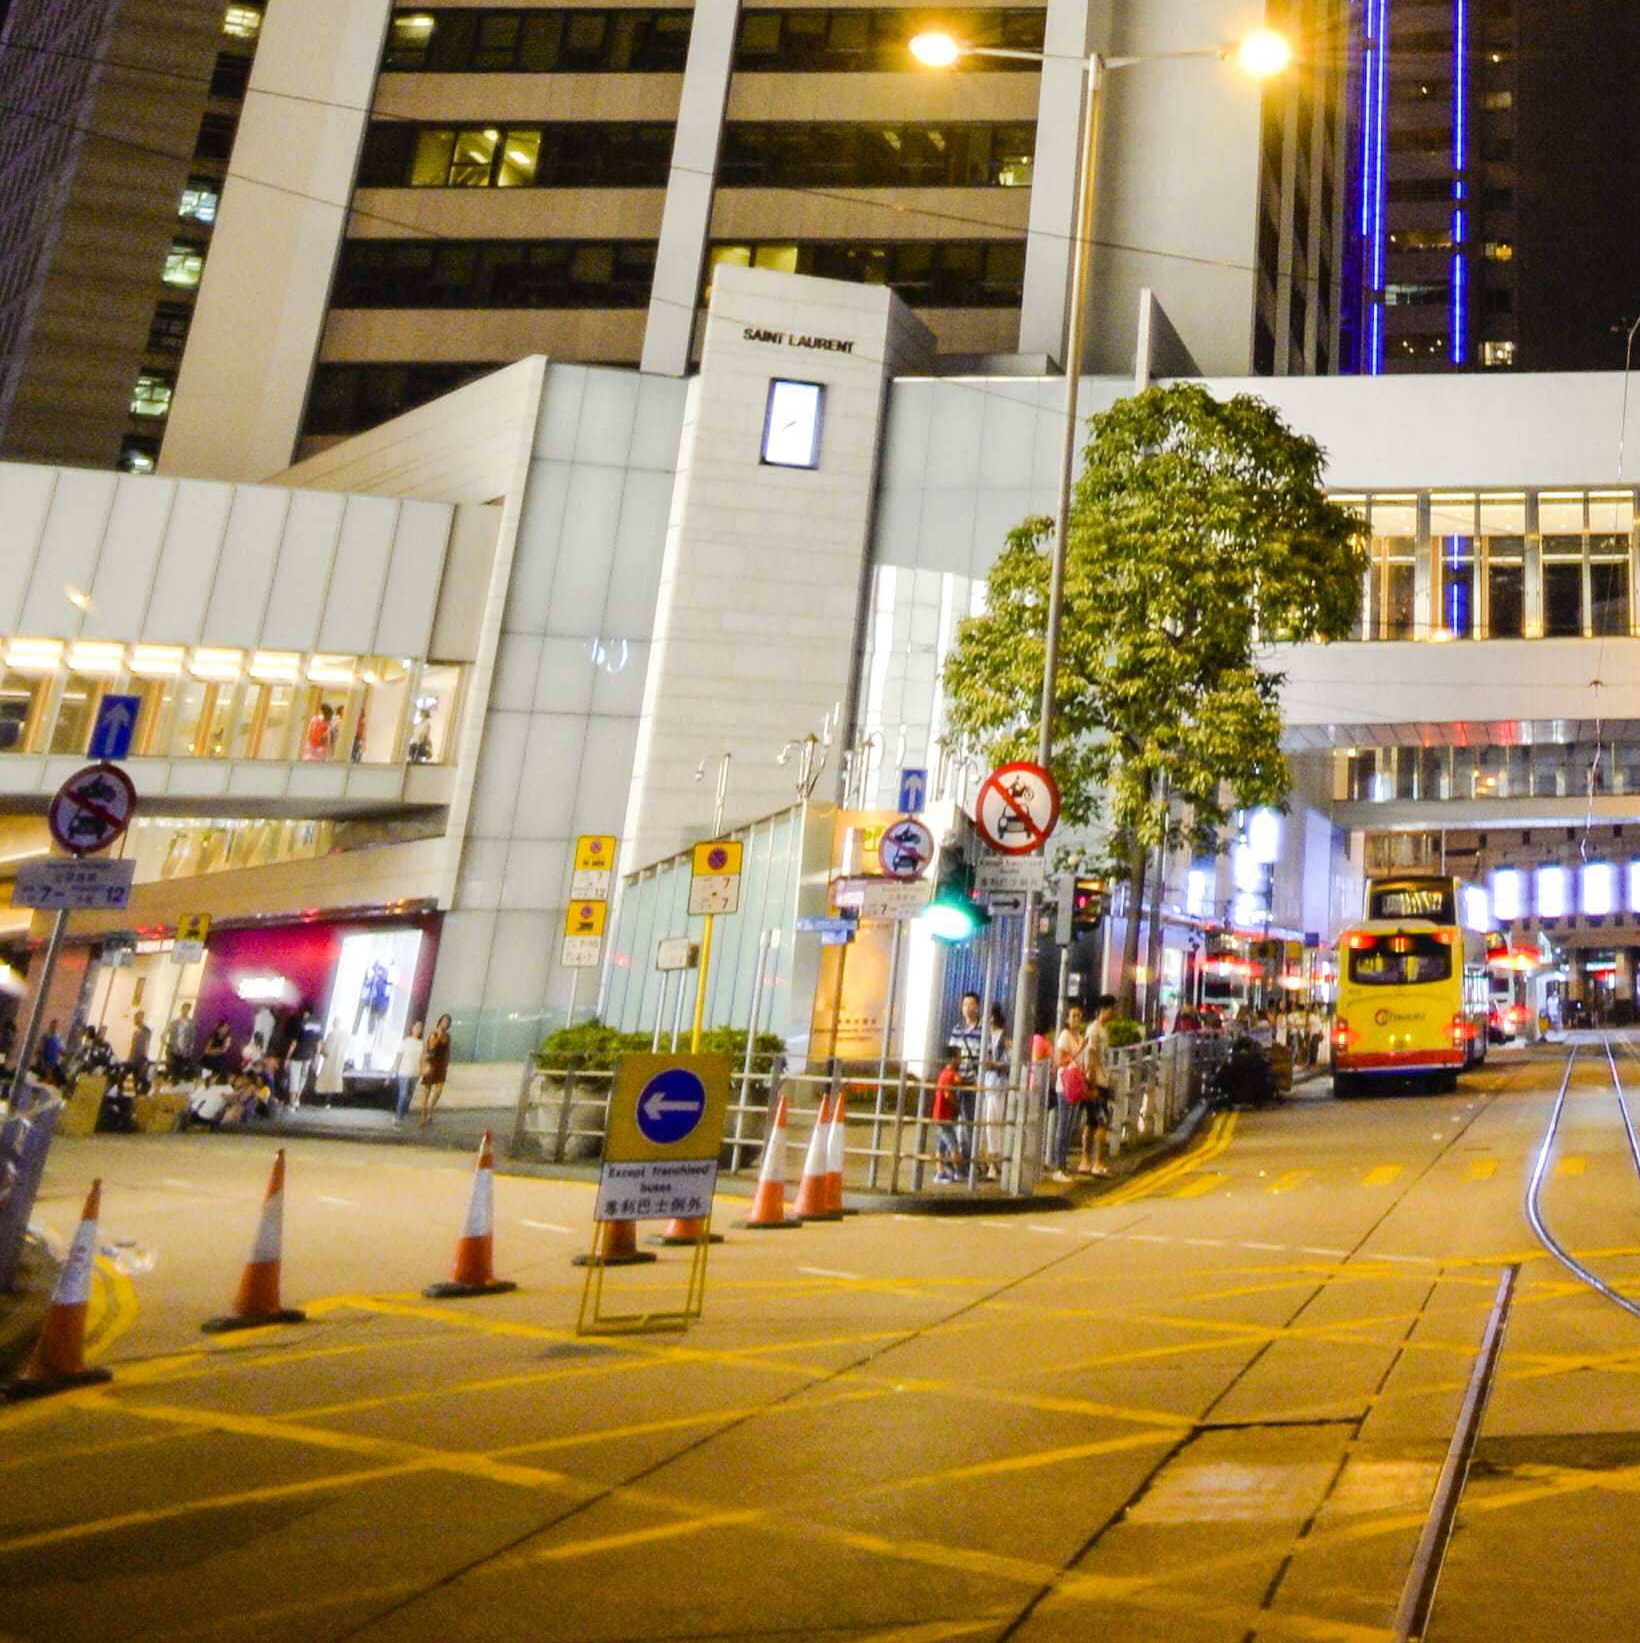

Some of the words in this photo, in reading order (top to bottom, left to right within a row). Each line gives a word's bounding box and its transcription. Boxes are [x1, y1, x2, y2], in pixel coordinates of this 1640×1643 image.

[743, 327, 783, 345] SAINT
[788, 334, 854, 354] LAURENT
[106, 886, 126, 903] 12
